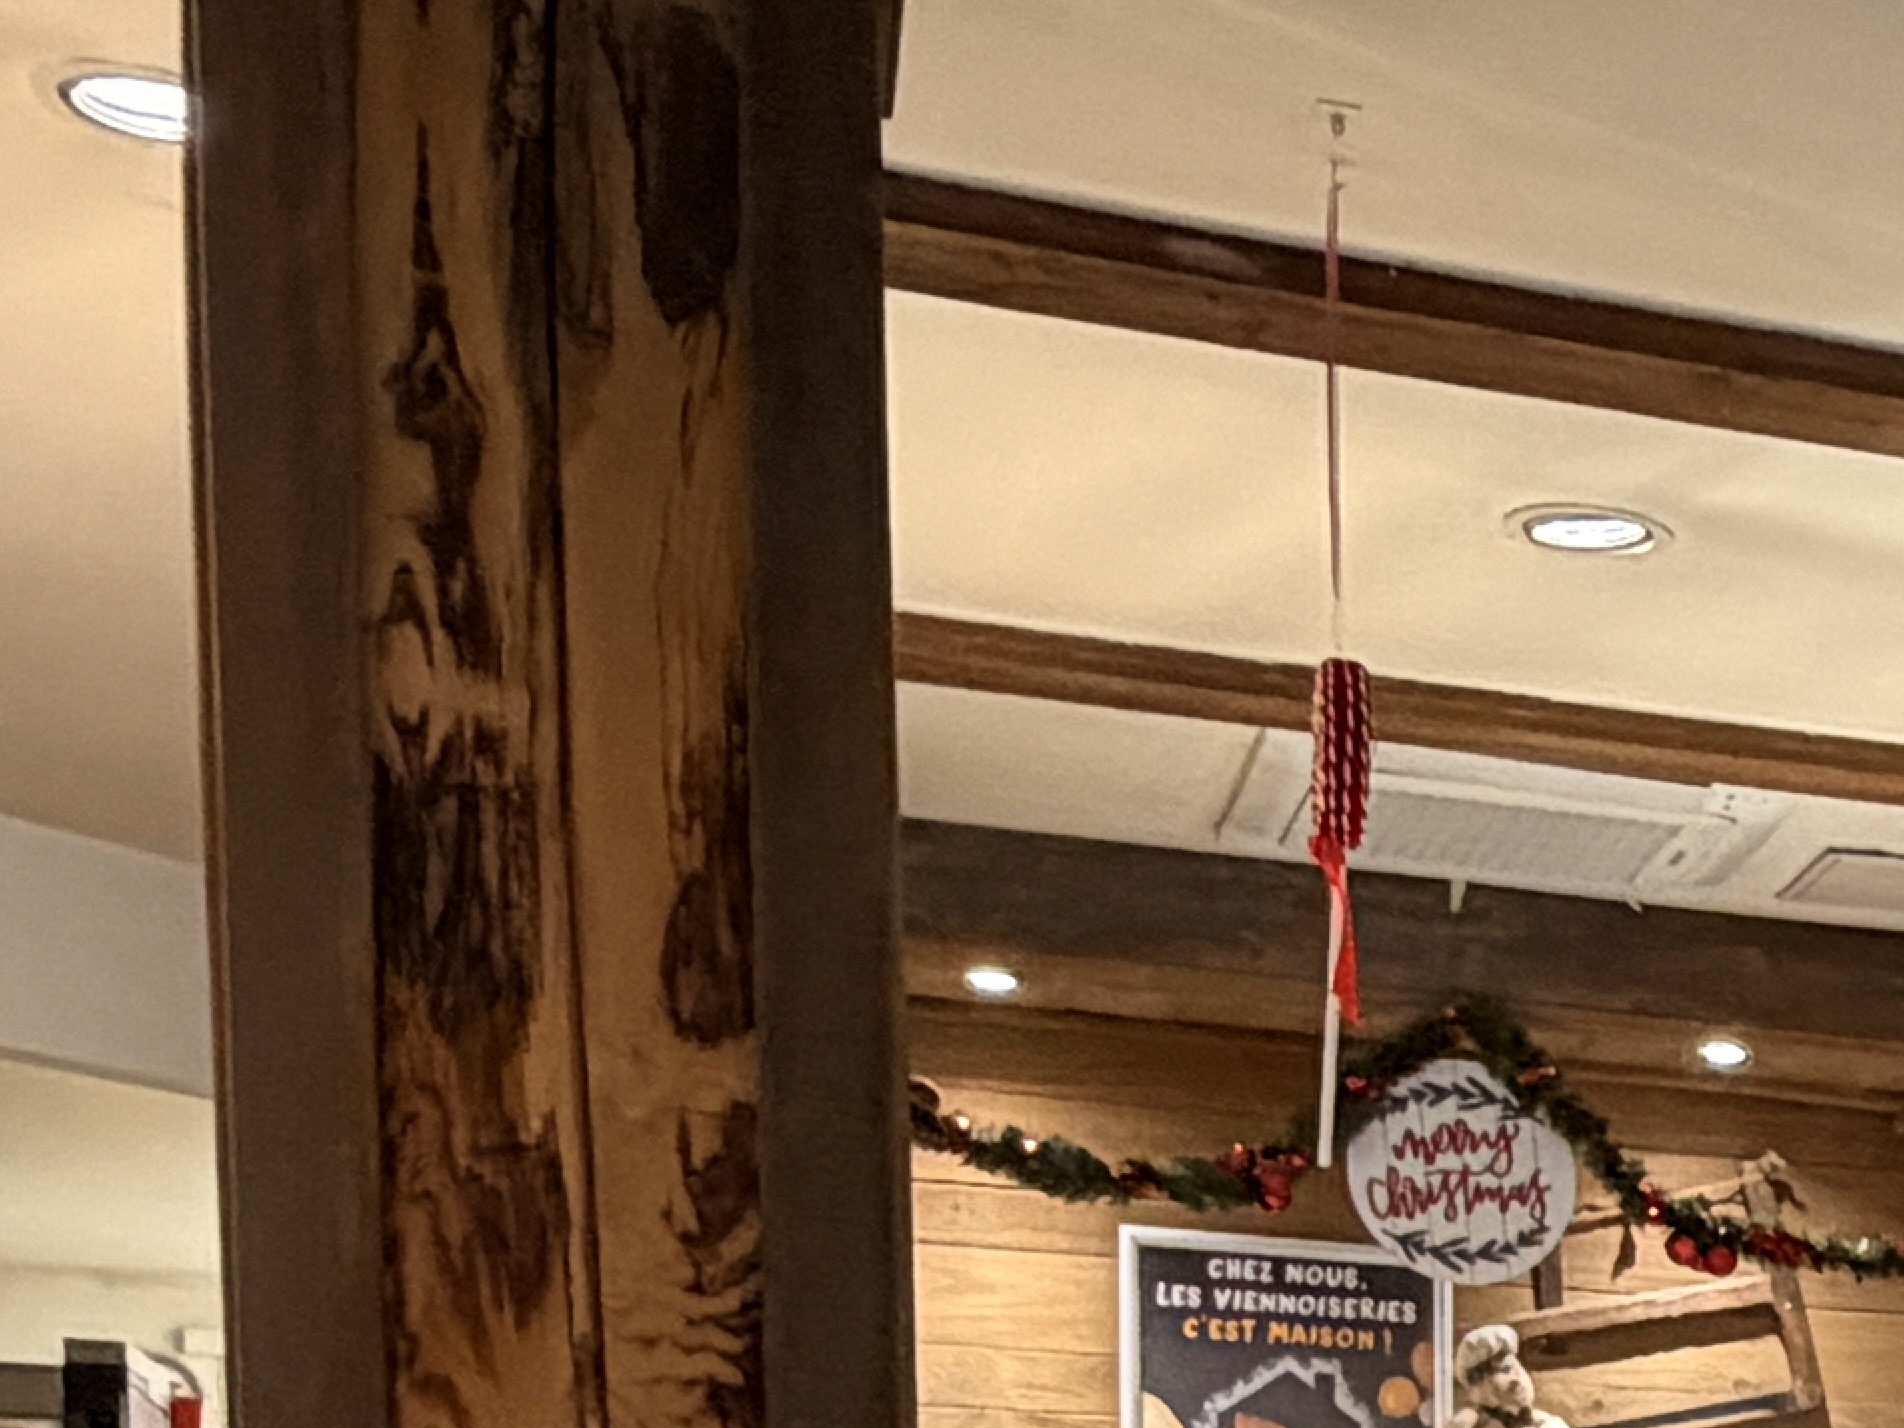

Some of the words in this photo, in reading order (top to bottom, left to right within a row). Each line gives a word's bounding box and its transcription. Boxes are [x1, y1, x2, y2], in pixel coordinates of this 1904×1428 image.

[1207, 1257, 1274, 1284] CHEZ
[1156, 1280, 1202, 1308] LES
[1214, 1287, 1418, 1325] VIENNOISERIES
[1182, 1313, 1258, 1344] C'EST
[1267, 1320, 1376, 1351] MAISON
